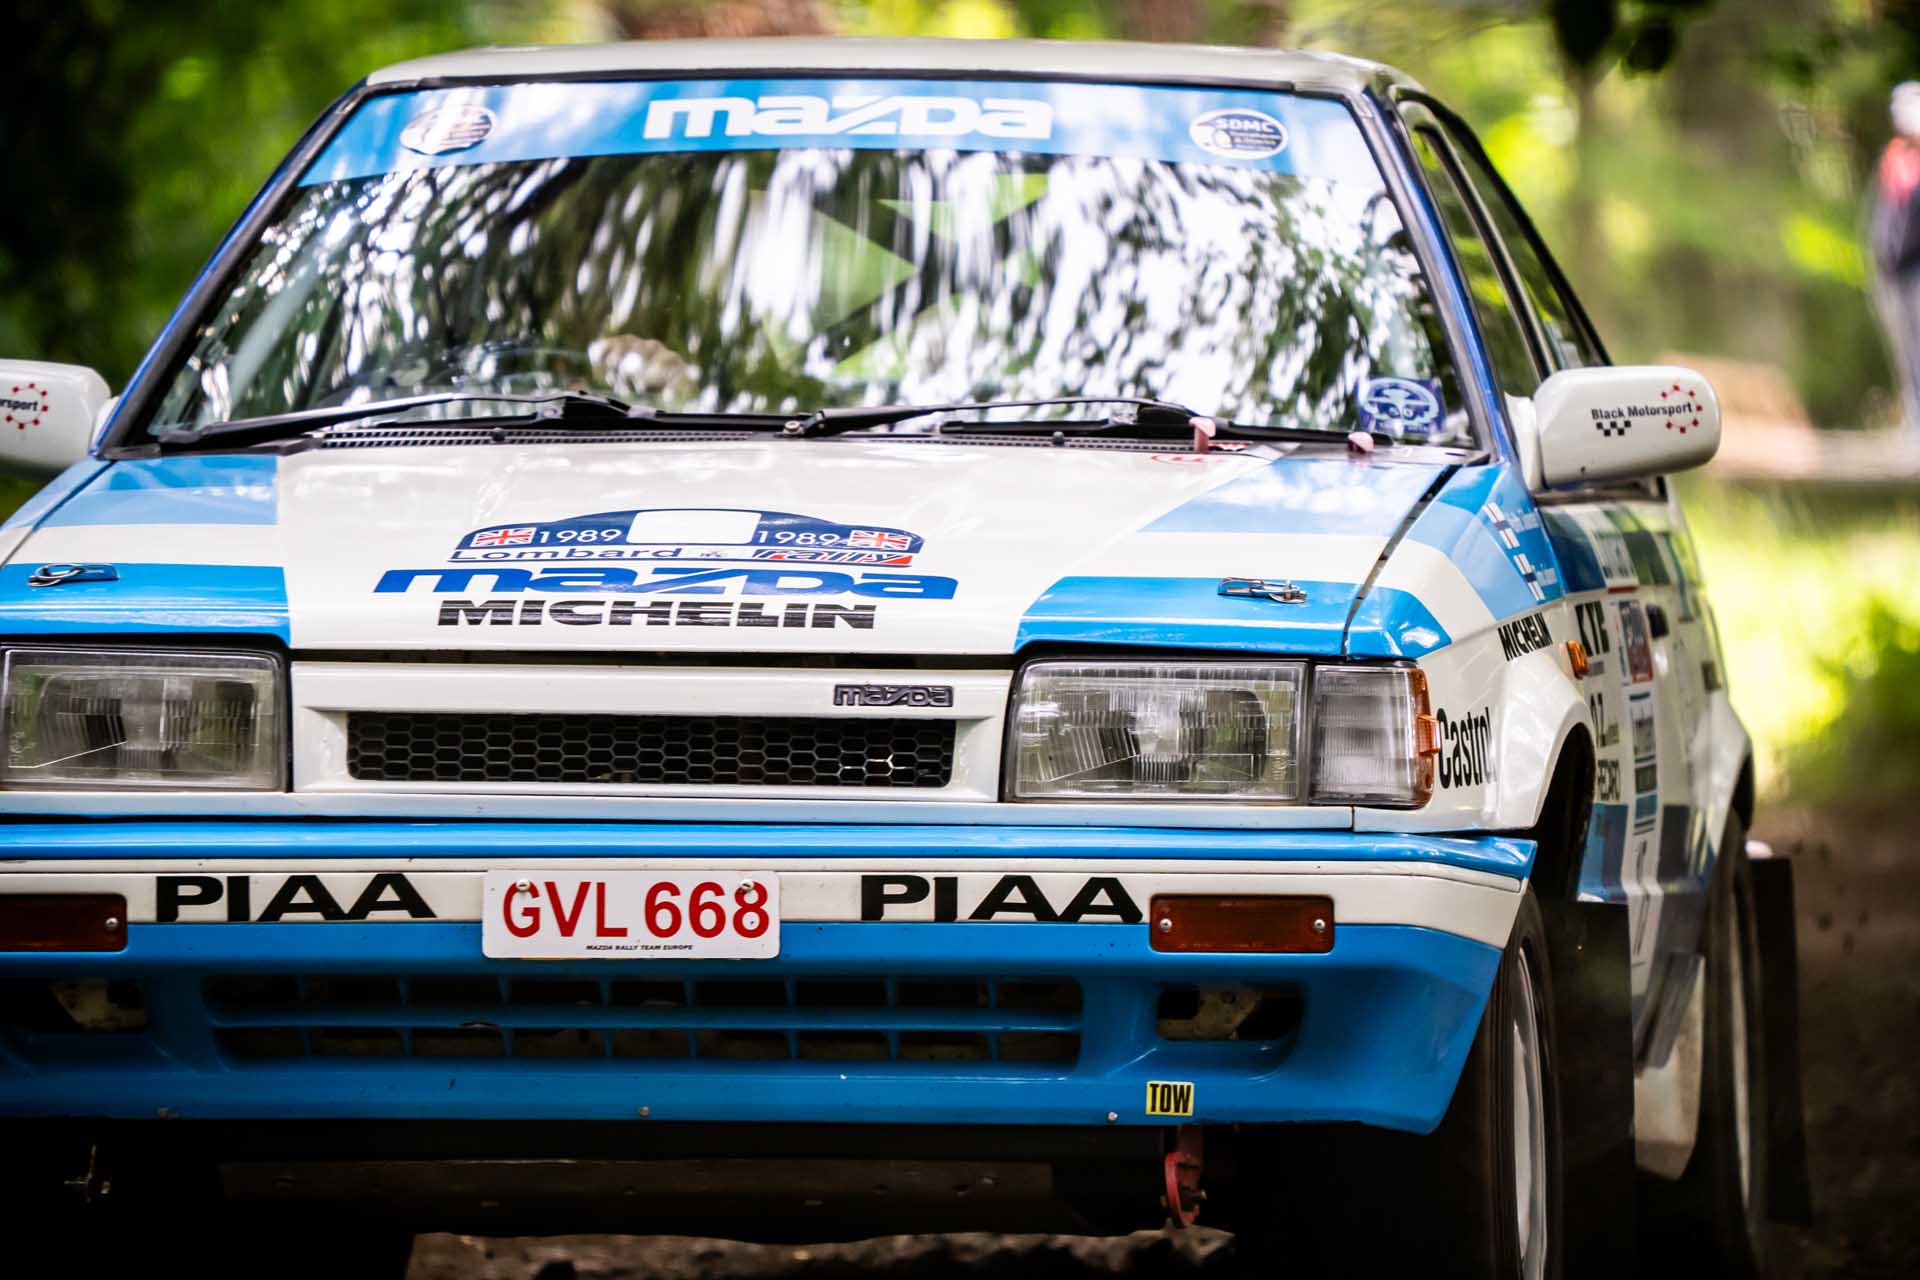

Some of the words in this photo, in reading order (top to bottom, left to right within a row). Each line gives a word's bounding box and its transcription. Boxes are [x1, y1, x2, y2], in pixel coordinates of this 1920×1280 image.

[1591, 407, 1625, 420] Black
[1627, 402, 1692, 417] Motorsport
[539, 528, 622, 544] 1989
[757, 530, 840, 545] 1989
[451, 548, 682, 560] Lombard
[437, 600, 877, 629] MICHELIN
[1498, 611, 1553, 661] MICHELIN
[1437, 706, 1497, 790] Castrol
[155, 873, 438, 922] PIAA
[503, 881, 628, 938] GVL
[644, 881, 770, 938] 668
[861, 874, 1143, 922] PIAA
[1149, 1083, 1192, 1113] TOW
